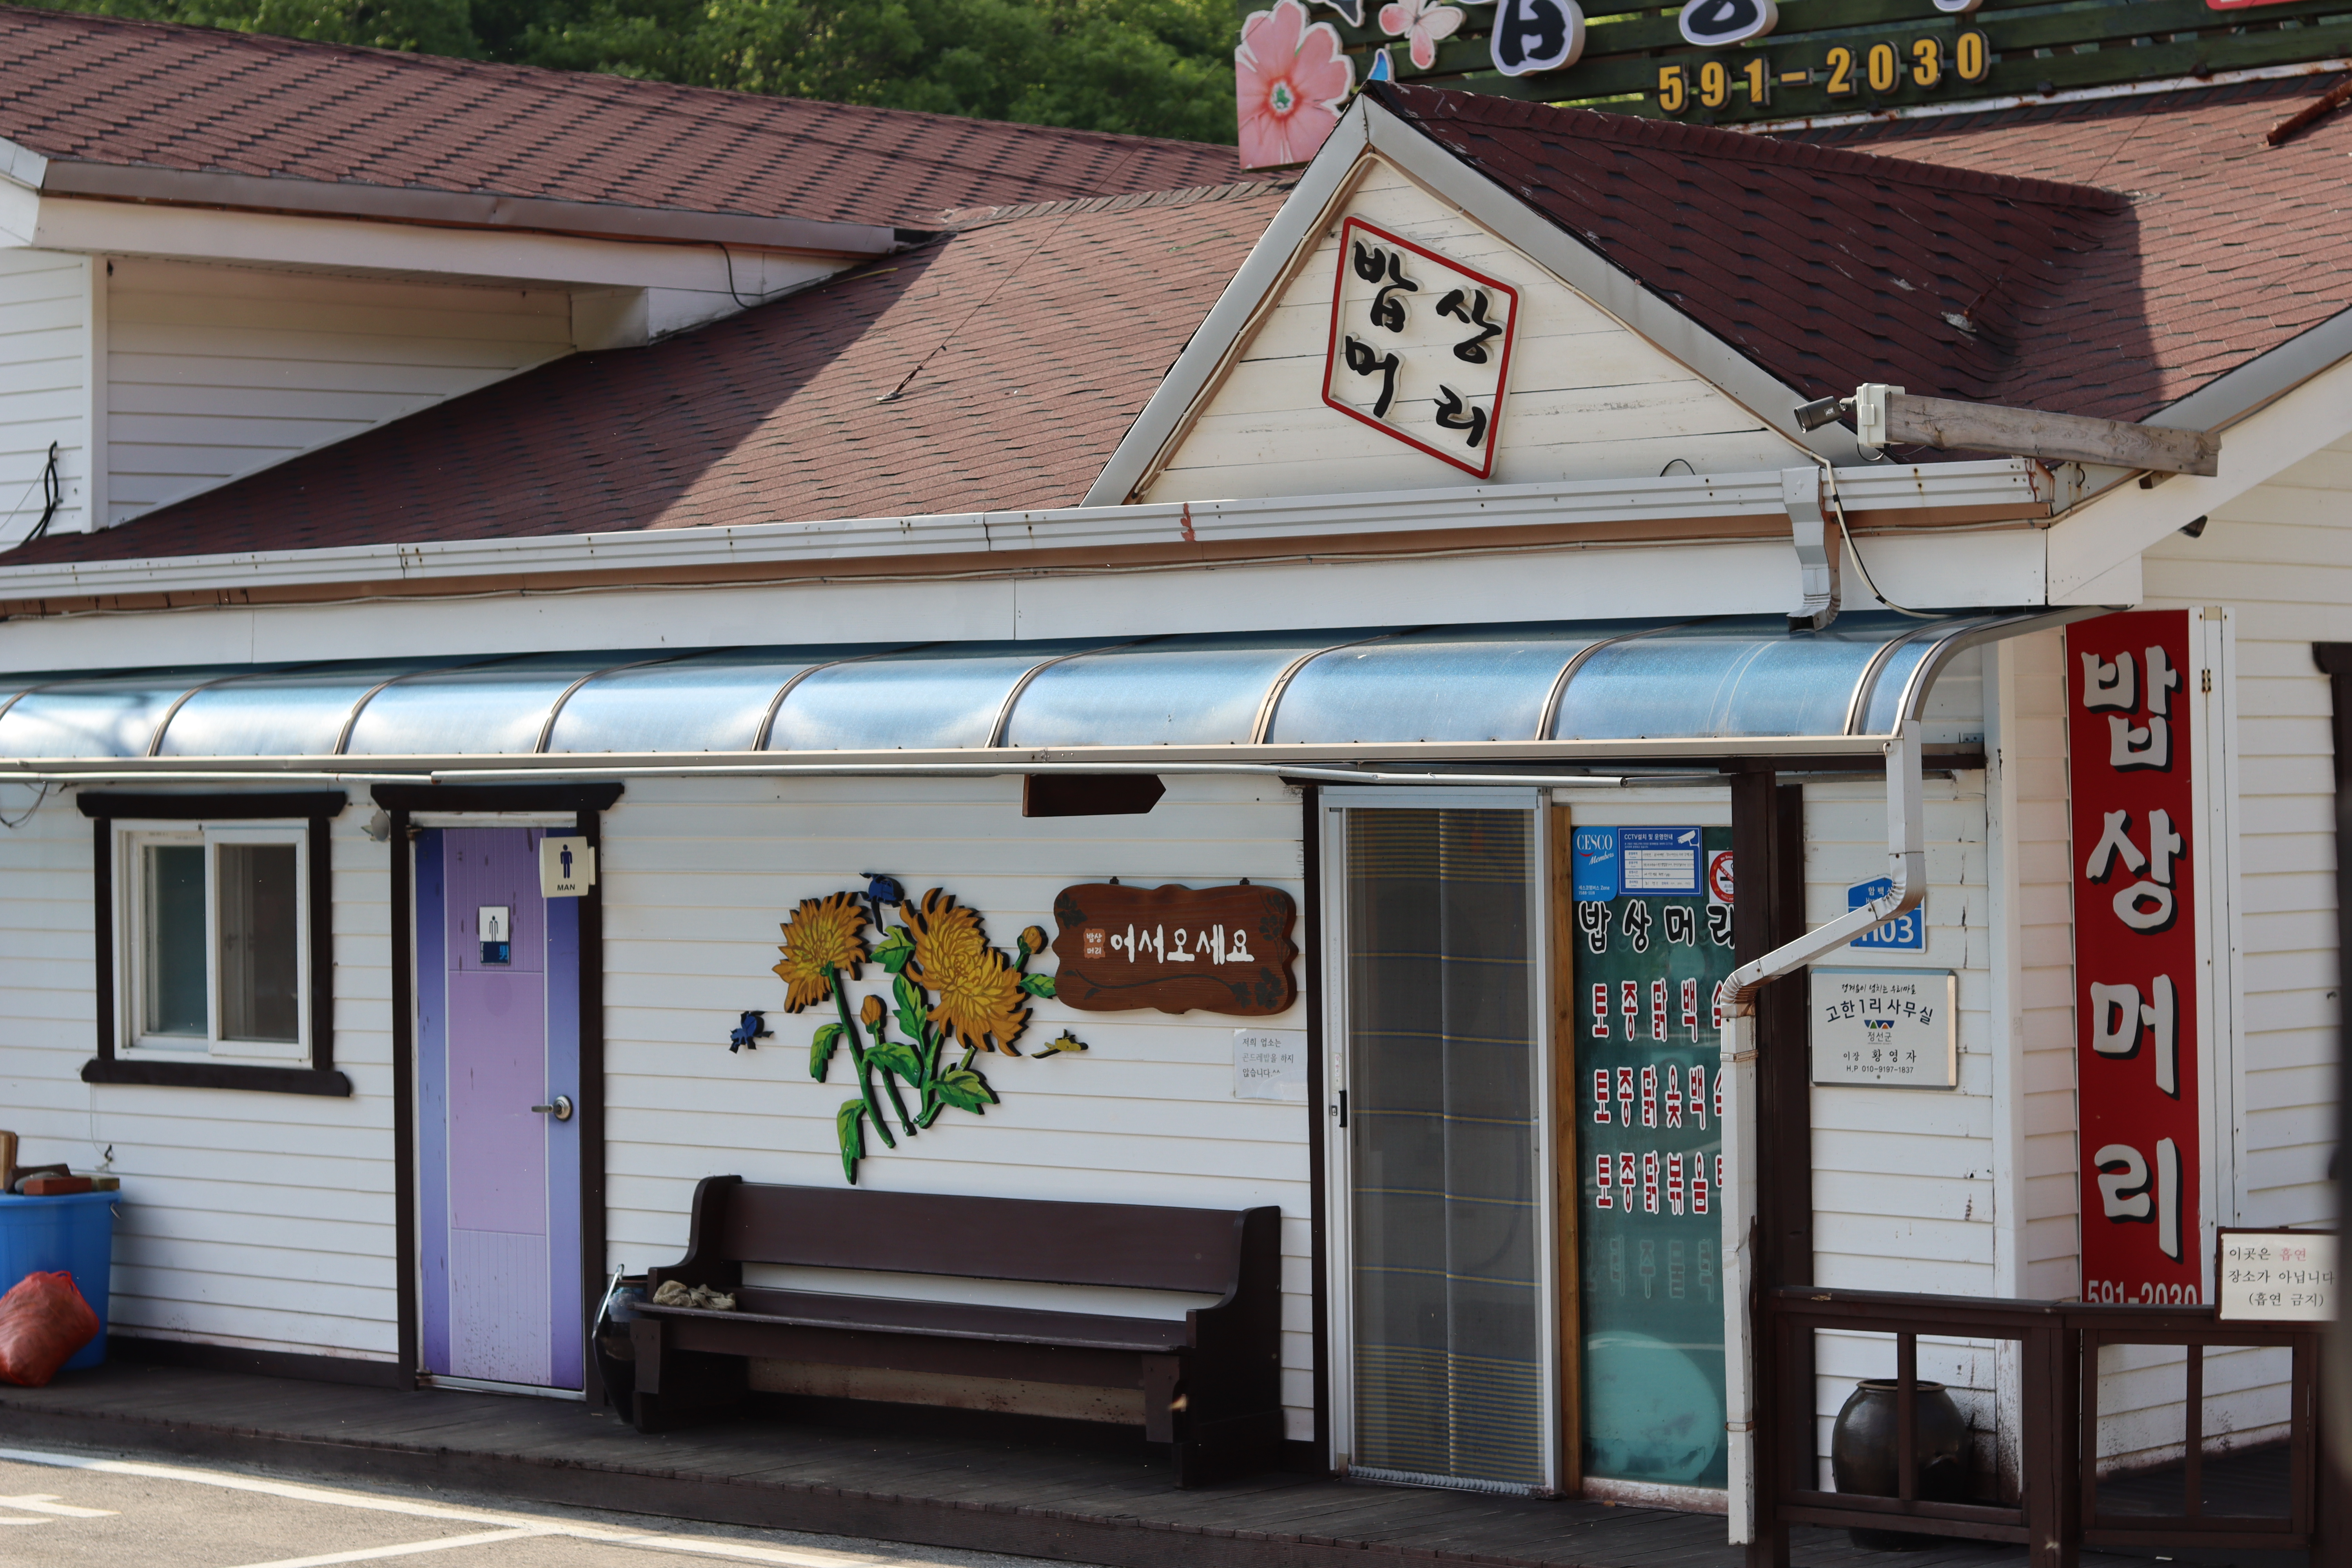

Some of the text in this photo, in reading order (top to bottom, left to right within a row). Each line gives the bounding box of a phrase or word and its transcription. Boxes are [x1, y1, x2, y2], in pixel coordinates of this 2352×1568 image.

[1657, 31, 1985, 114] 591-2030
[1577, 834, 1613, 850] CESCO
[1589, 851, 1614, 865] Members
[1086, 933, 1102, 943] 밥상
[1110, 924, 1255, 965] 어서오세요
[2081, 644, 2184, 1261] 밥상머리
[1842, 984, 1916, 995] 정겨움이 넘치는 우리마을
[1826, 998, 1933, 1025] 고한1리 사무실
[1243, 1038, 1281, 1047] 저희 업소는
[1868, 1032, 1892, 1042] 정선군
[1242, 1053, 1294, 1063] 곤드레밥을 하지
[1844, 1051, 1860, 1061] 이장
[1862, 1065, 1914, 1073] 010-9197-1837
[2230, 1247, 2306, 1261] 이곳은 흡연
[2228, 1269, 2335, 1285] 장소가 아닙니다
[2088, 1280, 2197, 1304] 591-2030
[2249, 1292, 2324, 1307] (흡연 금지)
